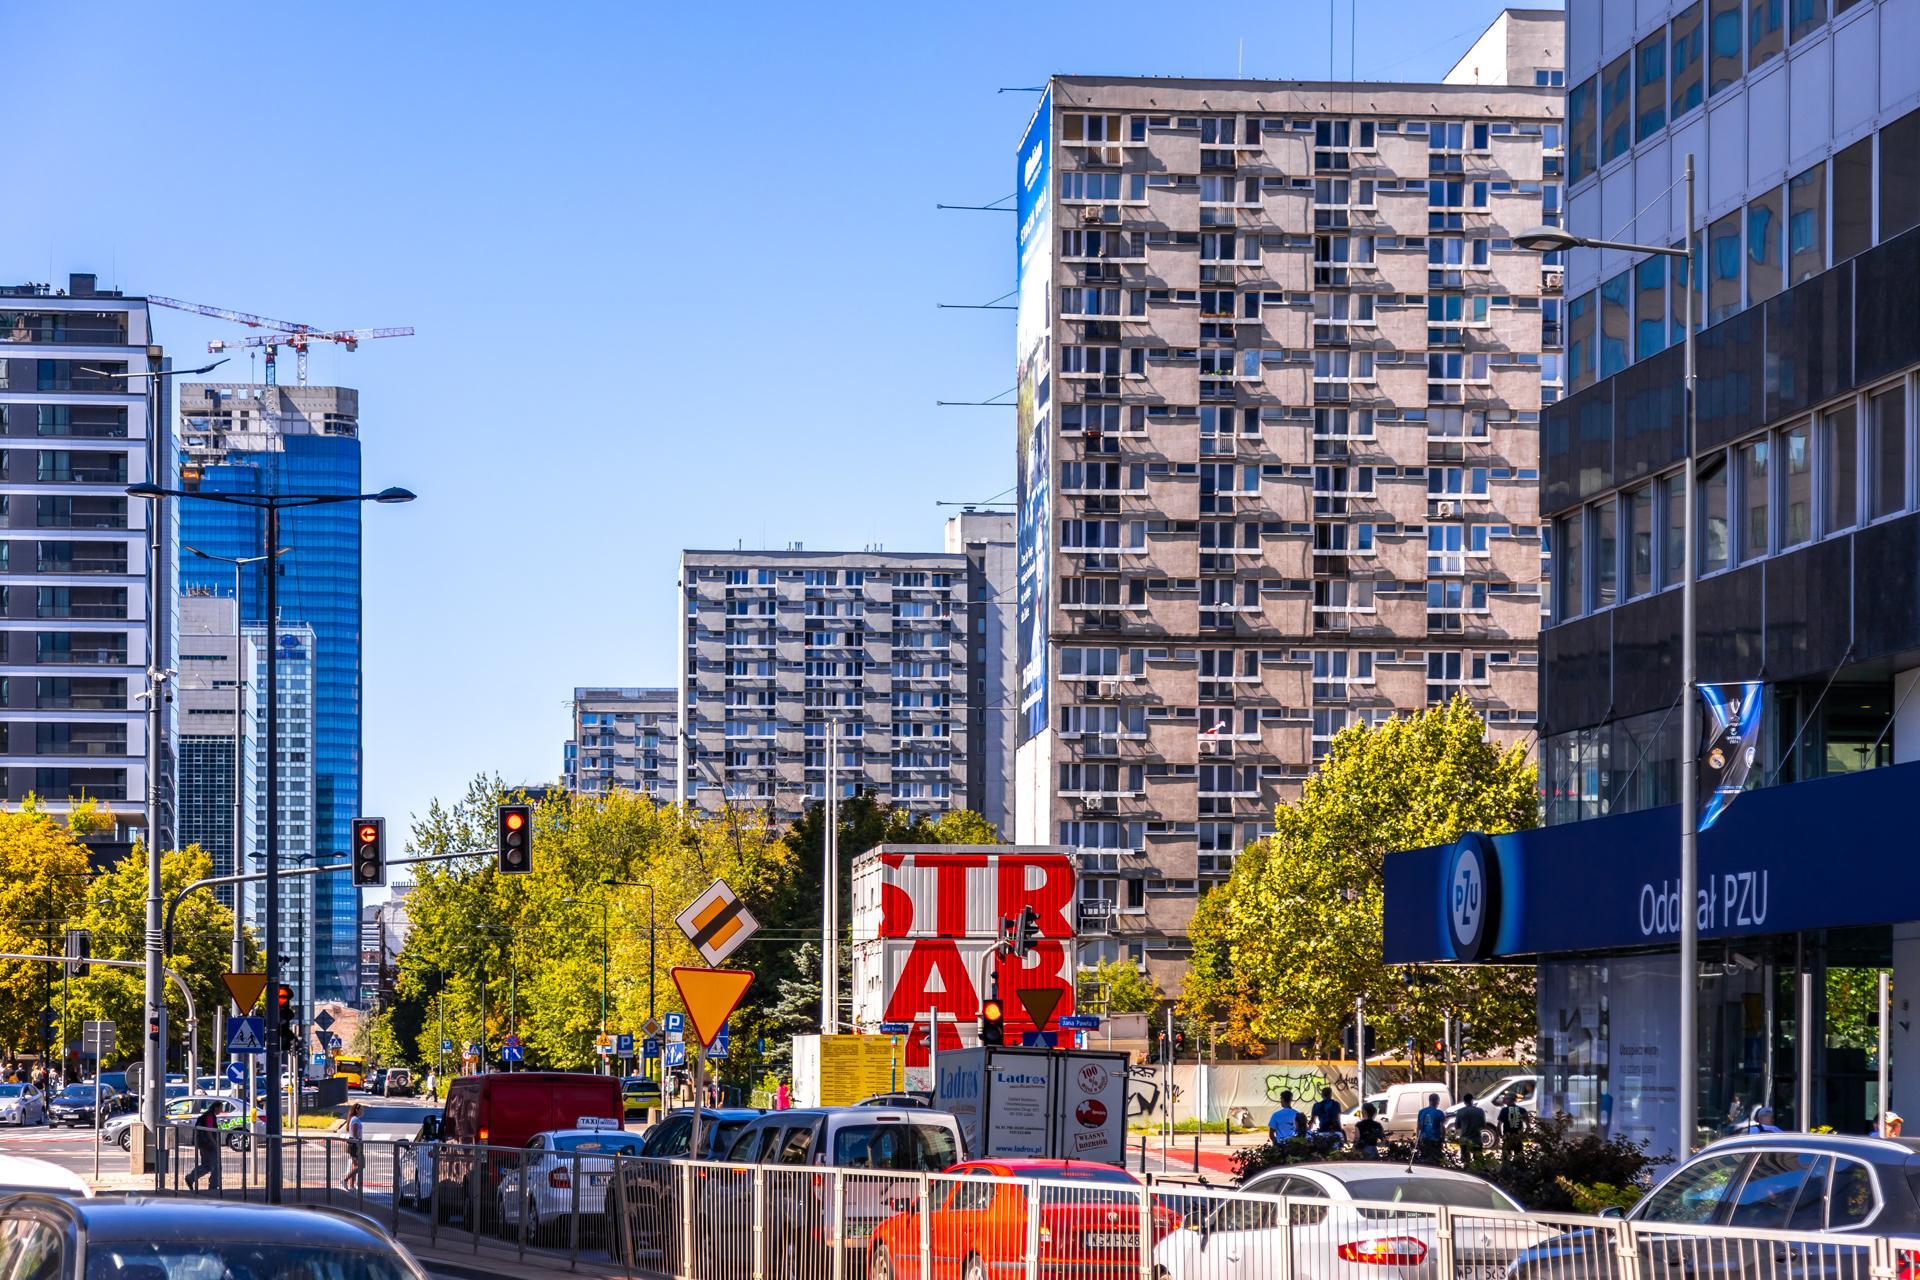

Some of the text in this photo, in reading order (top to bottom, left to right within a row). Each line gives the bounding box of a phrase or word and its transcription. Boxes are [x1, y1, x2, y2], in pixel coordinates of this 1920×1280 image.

[1455, 870, 1478, 925] PZU
[1640, 869, 1768, 935] Oddał PZU
[669, 1015, 680, 1030] P
[621, 1036, 630, 1049] P
[647, 1040, 656, 1053] P
[997, 1072, 1047, 1085] Ladros
[1082, 1066, 1098, 1079] 100
[940, 1066, 978, 1099] Ladros
[996, 1145, 1042, 1154] www.ladros.pl
